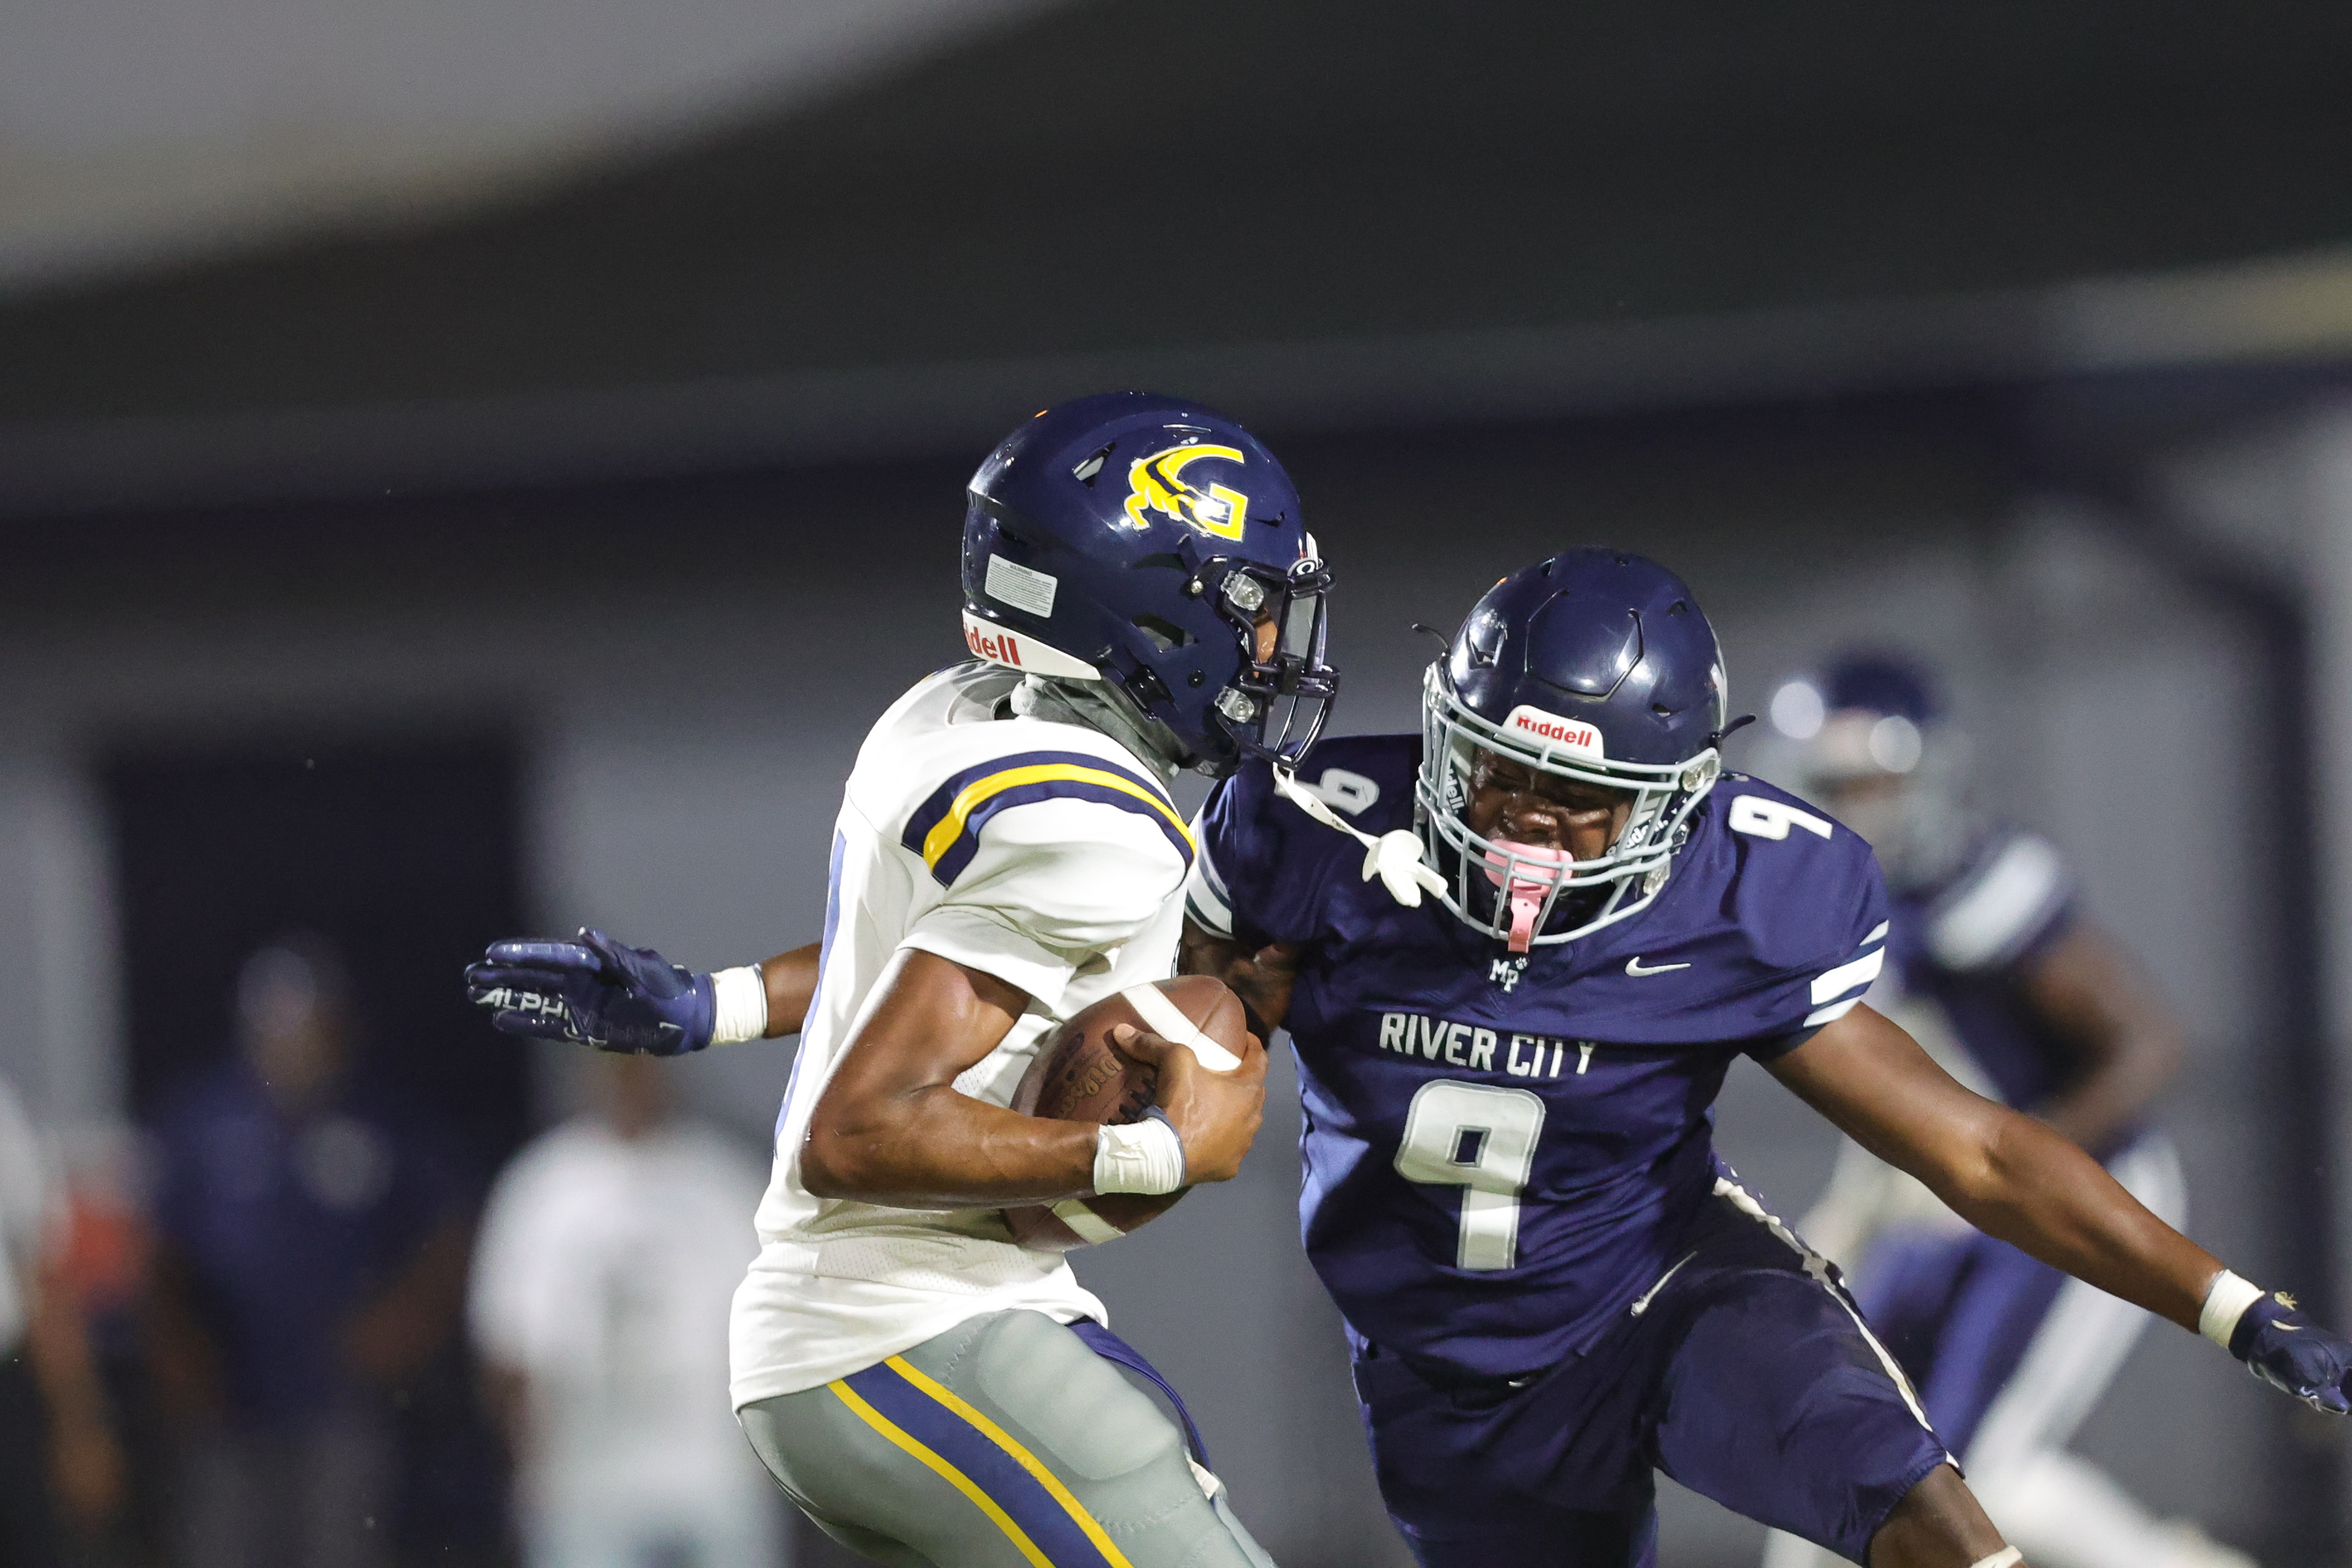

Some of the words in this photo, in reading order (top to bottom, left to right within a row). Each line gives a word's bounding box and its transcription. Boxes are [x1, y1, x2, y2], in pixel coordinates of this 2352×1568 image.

[1517, 715, 1592, 747] Riddell
[1729, 794, 1833, 841] 9
[1489, 959, 1518, 992] MP
[1379, 1012, 1497, 1072] RIVER
[1506, 1033, 1596, 1079] CITY
[1393, 1079, 1547, 1271] 9
